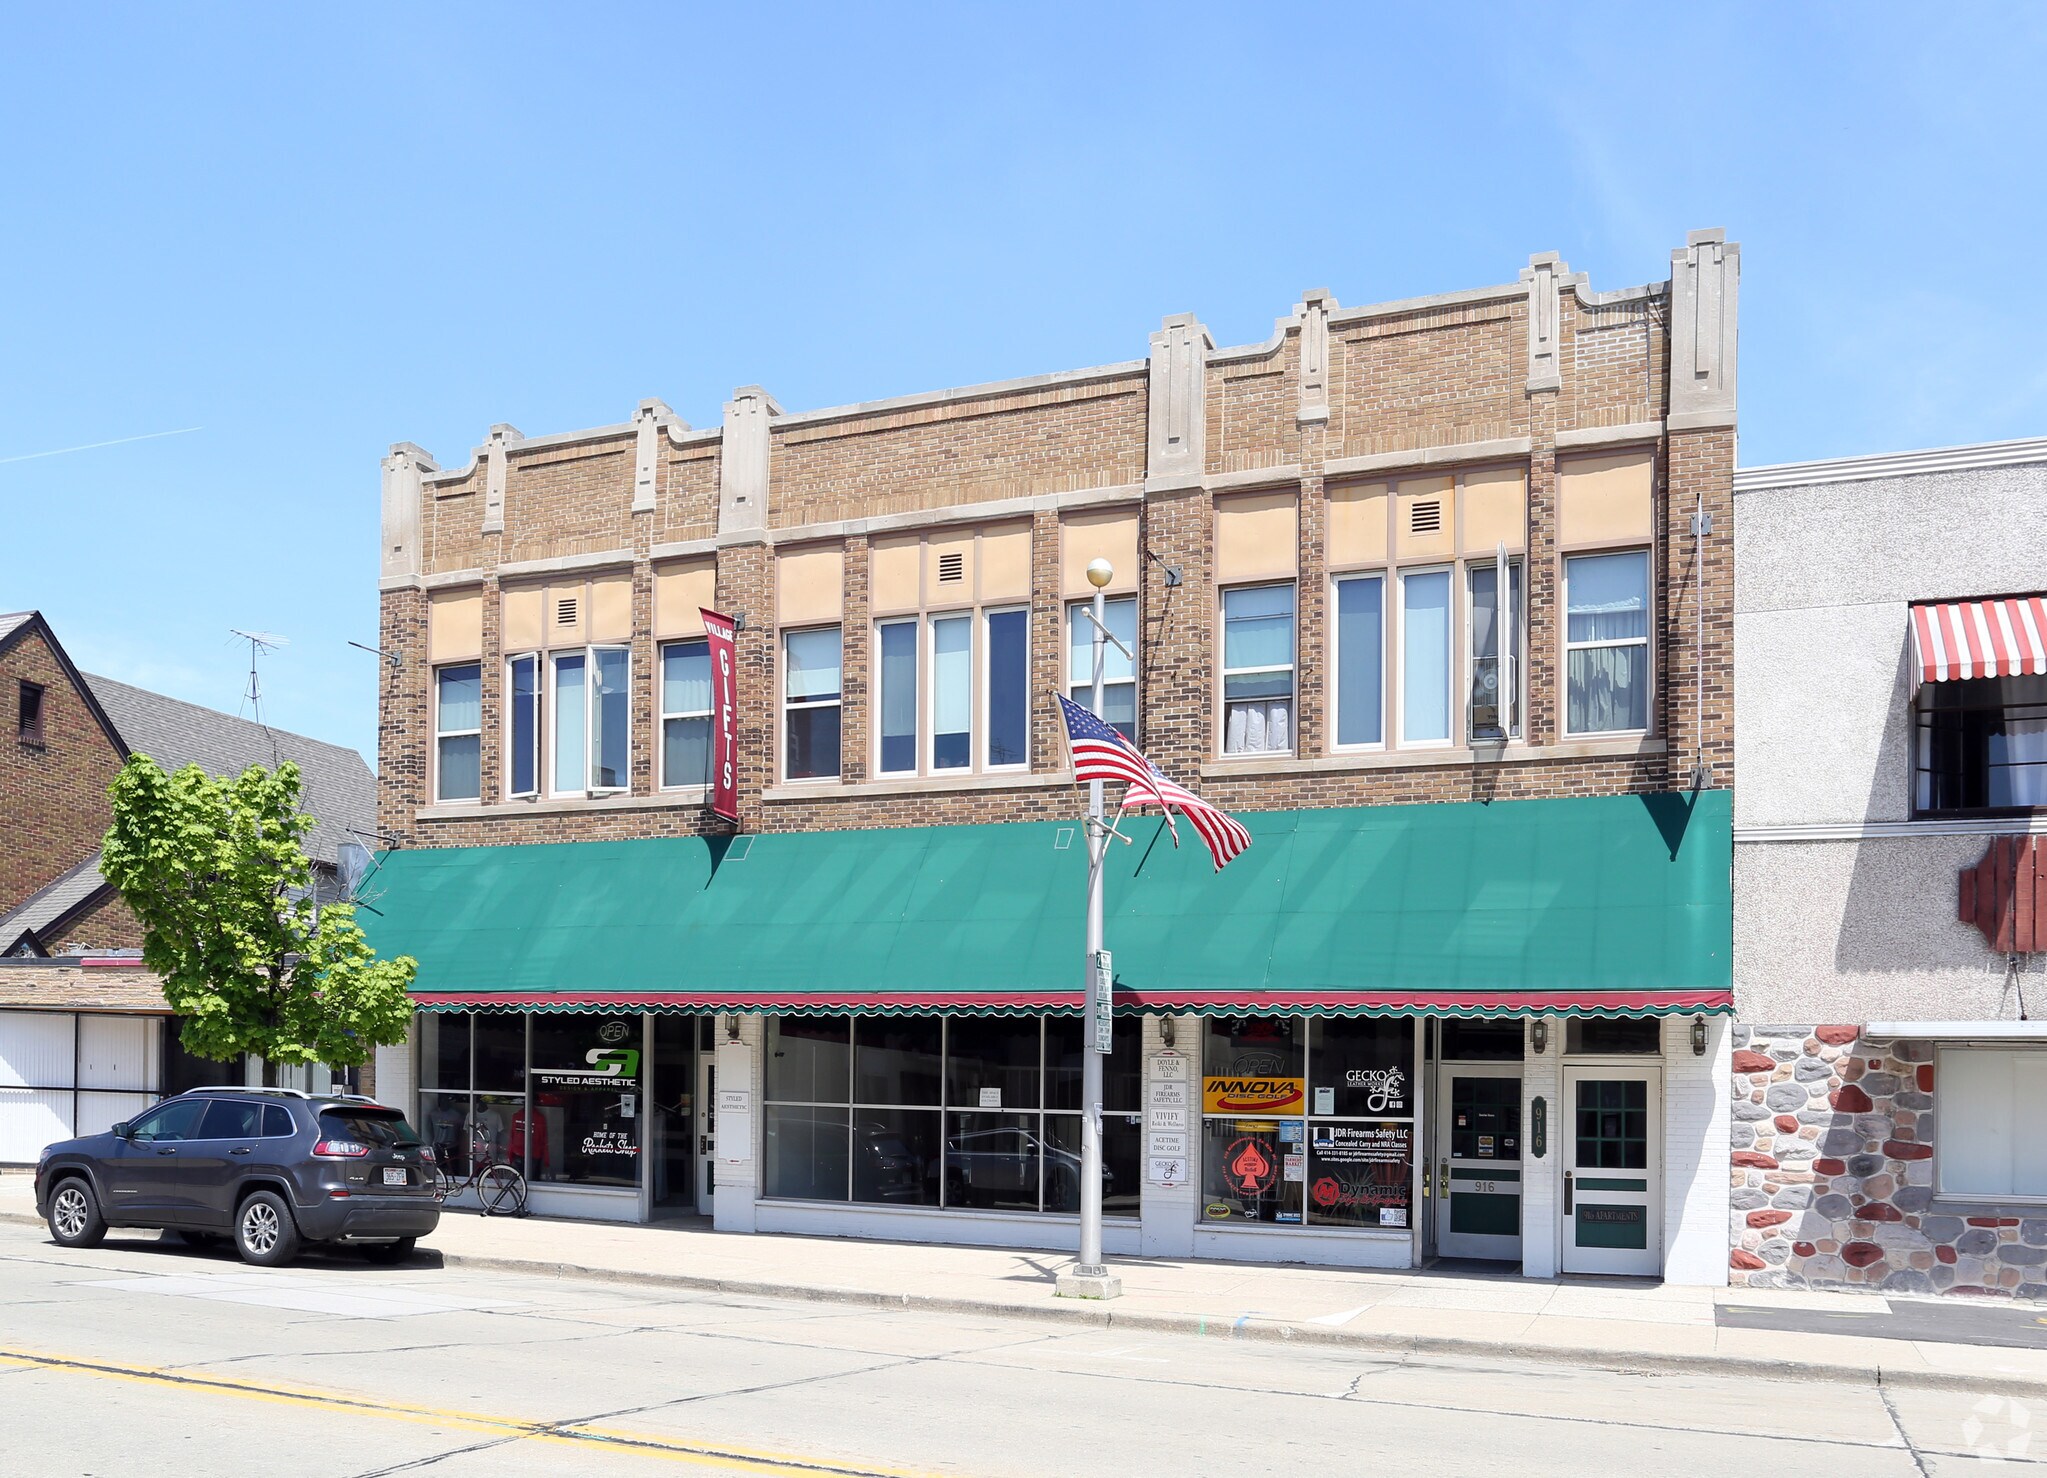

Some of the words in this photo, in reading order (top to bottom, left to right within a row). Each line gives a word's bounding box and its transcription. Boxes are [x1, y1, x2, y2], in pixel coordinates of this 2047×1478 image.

[705, 621, 734, 643] VILLAGE
[719, 648, 732, 790] GIFTS
[600, 1025, 629, 1037] OPEN
[1235, 1059, 1285, 1074] OPEN
[1346, 1070, 1387, 1081] GECKO
[541, 1076, 580, 1084] STYLED
[581, 1078, 636, 1087] AESTHETIC
[1206, 1081, 1295, 1094] INNOVA
[1155, 1112, 1178, 1120] VIVIFY
[1334, 1128, 1347, 1138] JDR
[1347, 1128, 1375, 1138] Firearms
[1375, 1128, 1396, 1140] Safety
[1396, 1129, 1408, 1139] LLC
[1359, 1140, 1371, 1148] Carry
[1391, 1141, 1407, 1149] Classes
[392, 1153, 405, 1161] Jeep
[1340, 1182, 1407, 1198] Dynamic
[1475, 1181, 1495, 1192] 916
[1595, 1210, 1639, 1221] APARTMENTS
